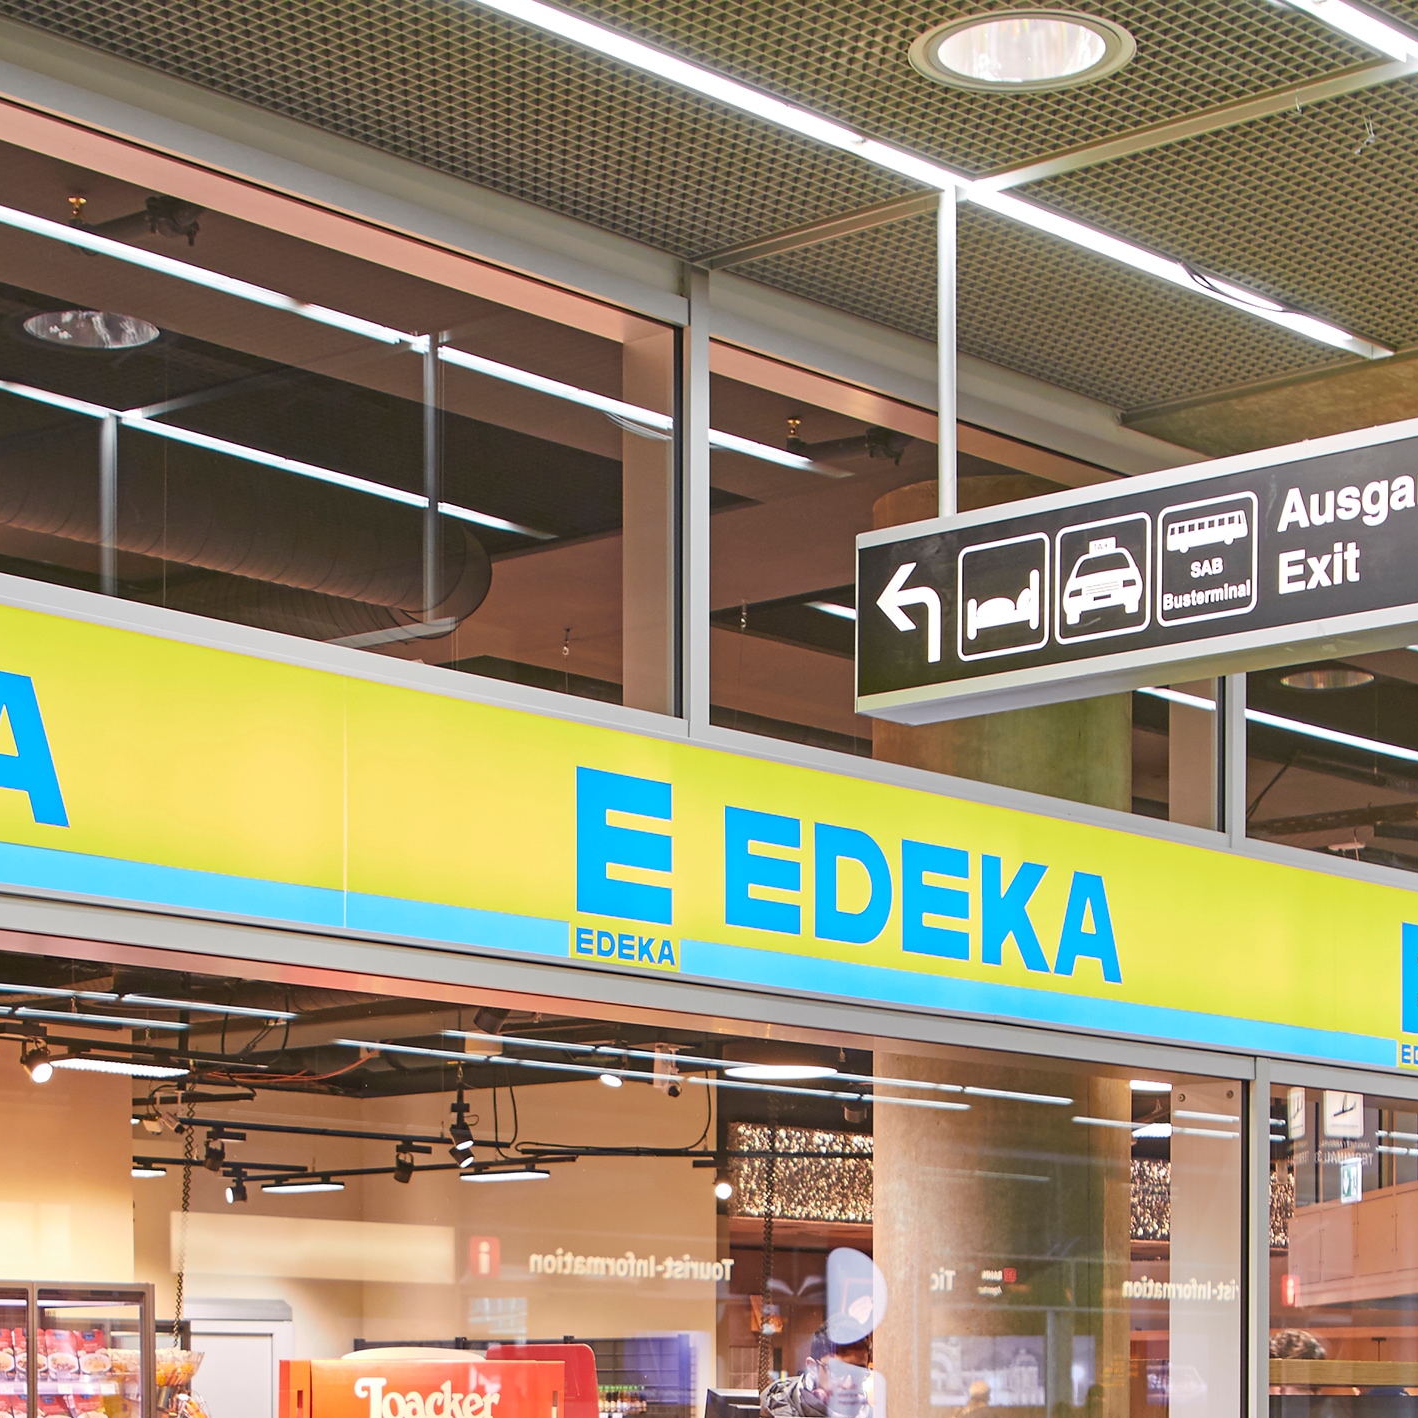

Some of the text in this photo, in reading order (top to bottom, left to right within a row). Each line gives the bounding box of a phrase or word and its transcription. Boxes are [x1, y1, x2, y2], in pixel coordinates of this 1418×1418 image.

[1189, 556, 1224, 579] SAB
[1278, 541, 1361, 595] Exit
[1162, 578, 1252, 611] Busterminal
[576, 766, 672, 926] E
[724, 805, 1123, 984] EDEKA
[576, 927, 676, 967] EDEKA
